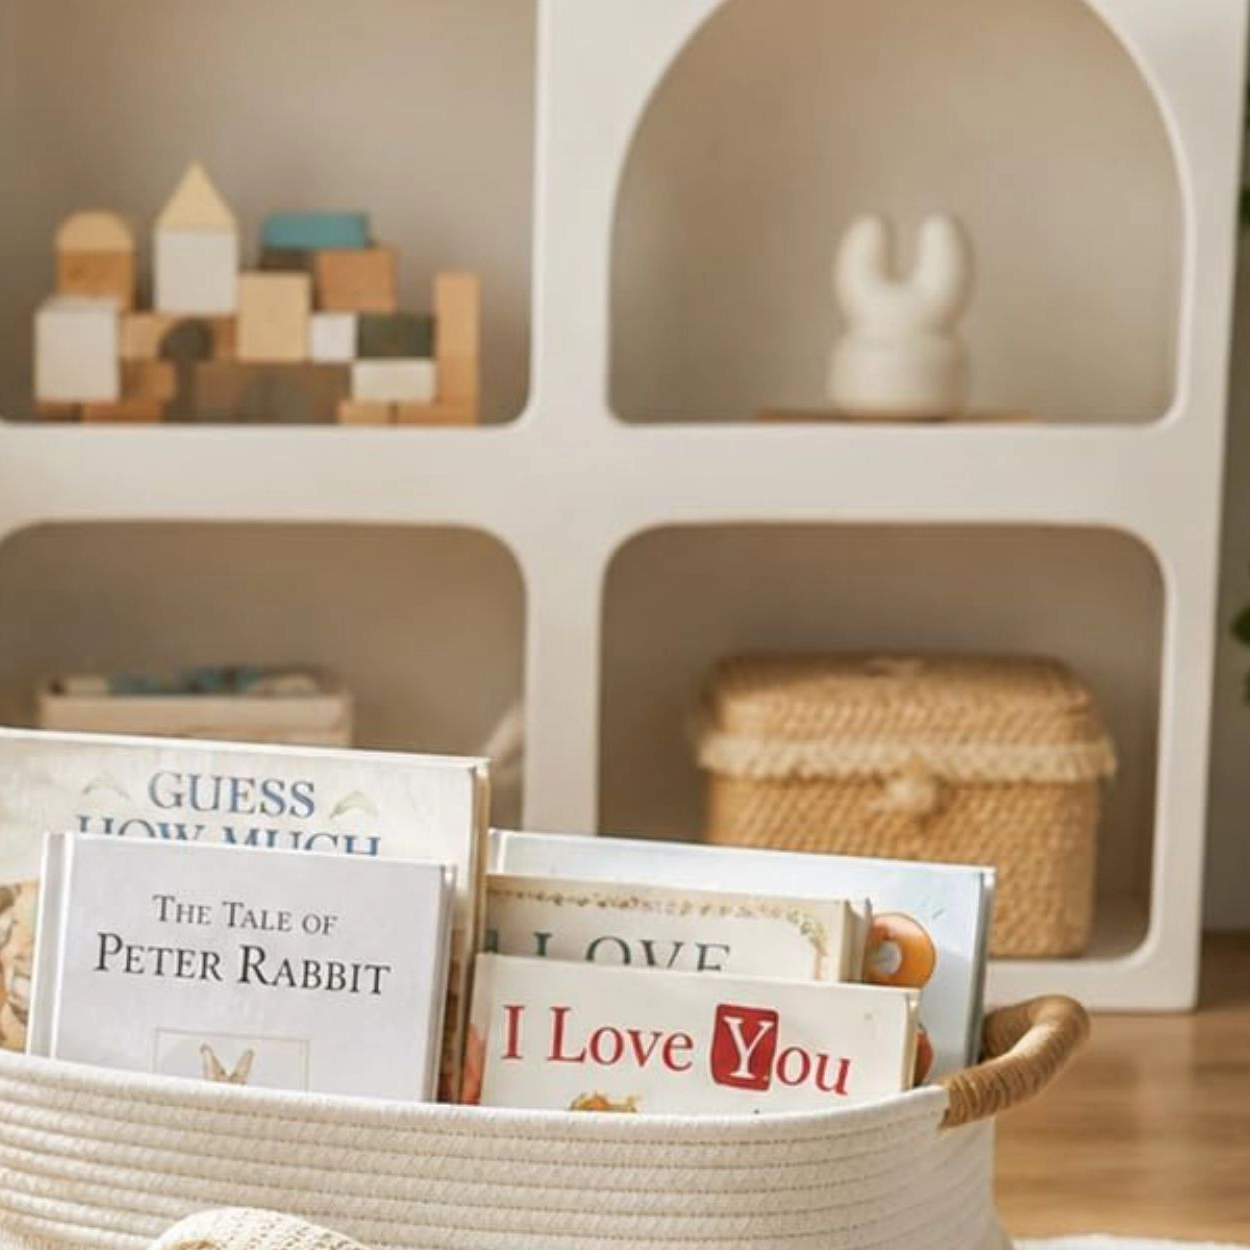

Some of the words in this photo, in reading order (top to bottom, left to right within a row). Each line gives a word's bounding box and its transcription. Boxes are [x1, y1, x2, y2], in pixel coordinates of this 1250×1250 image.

[148, 770, 317, 818] GUESS
[501, 1004, 525, 1060] I
[546, 1005, 695, 1072] Love
[720, 1012, 853, 1096] You
